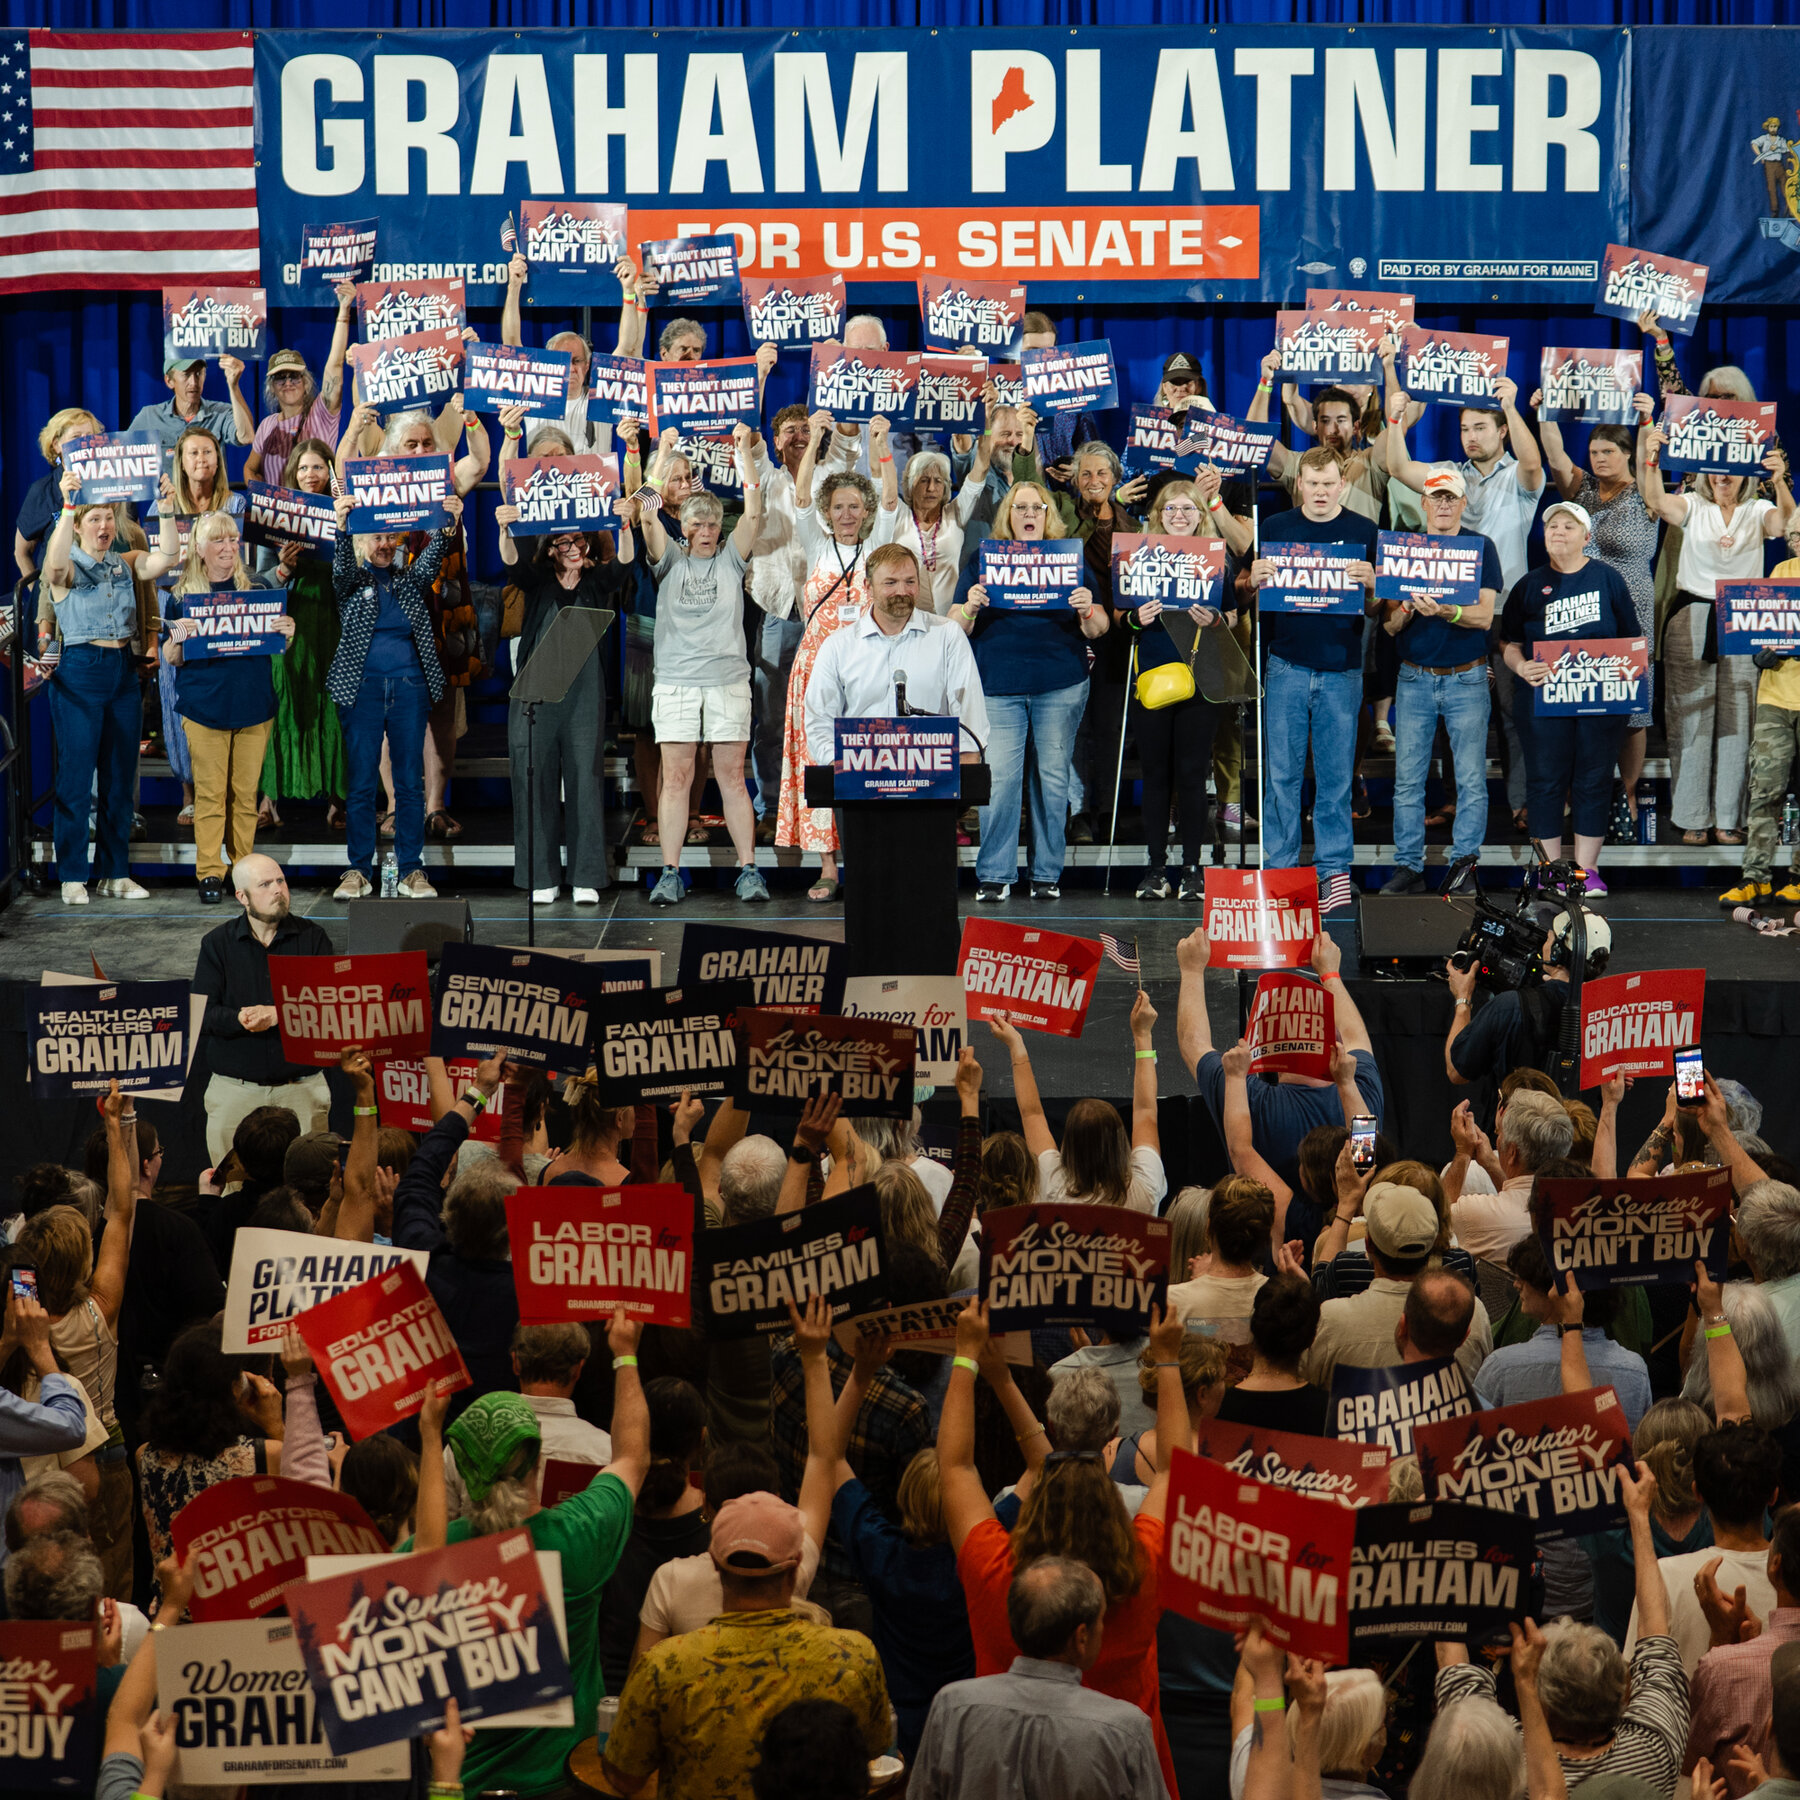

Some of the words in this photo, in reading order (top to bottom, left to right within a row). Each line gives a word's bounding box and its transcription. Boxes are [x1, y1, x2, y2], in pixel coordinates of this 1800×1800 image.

[281, 51, 908, 195] GRAHAM
[970, 47, 1601, 193] PLATNER
[558, 213, 611, 230] Senator
[528, 228, 620, 244] MONEY
[677, 222, 800, 268] OR
[823, 221, 936, 268] U.S.
[958, 219, 1203, 268] SENATE
[527, 242, 580, 263] CAN'T
[584, 243, 619, 264] BUY
[283, 263, 529, 285] GFORSENATE.CO
[1383, 264, 1412, 276] PAID
[1414, 264, 1441, 276] FOR
[1444, 264, 1461, 276] BY
[1463, 265, 1520, 277] GRAHAM
[1523, 265, 1549, 277] FOR
[1552, 265, 1593, 277] MAINE
[1639, 263, 1691, 290] Senator
[1607, 270, 1696, 303] MONEY
[201, 297, 252, 314] Senator
[953, 289, 1009, 311] Senator
[1604, 285, 1653, 312] CAN'T
[1657, 298, 1691, 322] BUY
[172, 312, 258, 328] MONEY
[929, 301, 1016, 325] MONEY
[172, 328, 222, 348] CAN'T
[227, 328, 259, 348] BUY
[929, 315, 975, 340] CAN'T
[978, 323, 1015, 345] BUY
[1293, 321, 1311, 338] A
[1313, 320, 1368, 339] Senator
[1283, 337, 1375, 353] MONEY
[1438, 342, 1491, 362] Senator
[472, 355, 498, 369] THEY
[499, 358, 530, 373] DON'T
[532, 361, 566, 376] KNOW
[827, 358, 847, 375] A
[848, 360, 905, 380] Senator
[1281, 350, 1335, 371] CAN'T
[1339, 352, 1375, 373] BUY
[1408, 354, 1498, 378] MONEY
[471, 368, 564, 398] MAINE
[661, 382, 687, 393] THEY
[688, 380, 719, 392] DON'T
[722, 377, 754, 390] KNOW
[816, 371, 911, 393] MONEY
[1026, 365, 1112, 397] MAINE
[1407, 369, 1457, 393] CAN'T
[660, 390, 755, 415] MAINE
[815, 385, 869, 409] CAN'T
[872, 393, 910, 412] BUY
[1681, 408, 1700, 427] A
[1700, 409, 1759, 430] Senator
[1669, 422, 1766, 445] MONEY
[68, 448, 94, 463] THEY
[95, 446, 124, 460] DON'T
[126, 443, 157, 457] KNOW
[1668, 437, 1724, 463] CAN'T
[1727, 443, 1765, 464] BUY
[71, 456, 160, 482] MAINE
[351, 473, 377, 487] THEY
[378, 471, 412, 486] DON'T
[413, 468, 446, 483] KNOW
[544, 468, 603, 486] Senator
[352, 481, 446, 508] MAINE
[513, 481, 611, 503] MONEY
[576, 496, 612, 518] BUY
[984, 552, 1010, 565] THEY
[1011, 553, 1043, 565] DON'T
[1045, 552, 1079, 565] KNOW
[1129, 544, 1149, 562] A
[1150, 544, 1208, 565] Senator
[1382, 544, 1409, 558] THEY
[1410, 546, 1442, 560] DON'T
[1443, 548, 1478, 562] KNOW
[985, 565, 1078, 586] MAINE
[1119, 560, 1214, 582] MONEY
[1381, 556, 1476, 582] MAINE
[1119, 575, 1179, 598] CAN'T
[1181, 578, 1214, 602] BUY
[1545, 590, 1600, 615] GRAHAM
[1545, 602, 1600, 627] PLATNER
[1730, 599, 1757, 610] THEY
[1758, 599, 1788, 610] DON'T
[1574, 650, 1632, 668] Senator
[1545, 664, 1639, 684] MONEY
[1543, 681, 1599, 704] CAN'T
[1602, 680, 1640, 702] BUY
[841, 733, 871, 746] THEY
[874, 733, 910, 746] DON'T
[913, 733, 953, 746] KNOW
[842, 748, 953, 771] MAINE
[865, 780, 897, 788] GRAHAM
[898, 780, 930, 788] PLATNER
[1212, 897, 1290, 909] EDUCATORS
[1208, 908, 1314, 942] GRAHAM
[699, 945, 830, 981] GRAHAM
[968, 946, 1069, 975] EDUCATORS
[281, 984, 384, 1004] LABOR
[448, 974, 560, 1003] SENIORS
[963, 957, 1087, 1012] GRAHAM
[39, 1009, 119, 1024] HEALTH
[122, 1006, 178, 1020] CARE
[281, 998, 425, 1041] GRAHAM
[440, 990, 589, 1047] GRAHAM
[921, 1002, 956, 1027] for
[1587, 1000, 1674, 1024] EDUCATORS
[46, 1020, 154, 1037] WORKERS
[155, 1019, 173, 1032] for
[605, 1014, 721, 1040] FAMILIES
[1584, 1011, 1695, 1060] GRAHAM
[36, 1031, 183, 1074] GRAHAM
[798, 1030, 891, 1056] Senator
[1273, 1042, 1316, 1053] SENATE
[748, 1046, 901, 1076] MONEY
[748, 1066, 835, 1099] CAN'T
[842, 1071, 901, 1101] BUY
[1570, 1194, 1603, 1219] A
[1606, 1193, 1704, 1218] Senator
[533, 1221, 652, 1246] LABOR
[656, 1226, 682, 1249] for
[1553, 1207, 1716, 1239] MONEY
[1007, 1222, 1041, 1252] A
[1043, 1221, 1145, 1255] Senator
[1553, 1235, 1646, 1271] CAN'T
[1653, 1227, 1715, 1262] BUY
[713, 1231, 844, 1279] FAMILIES
[990, 1248, 1156, 1279] MONEY
[529, 1242, 686, 1294] GRAHAM
[710, 1236, 880, 1314] GRAHAM
[988, 1272, 1083, 1310] CAN'T
[1091, 1274, 1156, 1314] BUY
[1337, 1361, 1468, 1433] GRAHAM
[1452, 1434, 1488, 1471] A
[1491, 1423, 1599, 1463] Senator
[1256, 1451, 1358, 1494] Senator
[1437, 1439, 1614, 1500] MONEY
[1551, 1466, 1618, 1515] BUY
[187, 1506, 341, 1552] EDUCATORS
[1177, 1494, 1291, 1562] LABOR
[192, 1519, 385, 1599] GRAHAM
[1170, 1521, 1339, 1627] GRAHAM
[336, 1595, 379, 1642] A
[381, 1576, 509, 1628] Senator
[319, 1592, 528, 1679] MONEY
[1354, 1621, 1468, 1637] GRAHAMFORSENATE.COM
[330, 1650, 452, 1722] CAN'T
[457, 1625, 541, 1691] BUY
[223, 1756, 348, 1773] GRAHAMFORSENATE.COM
